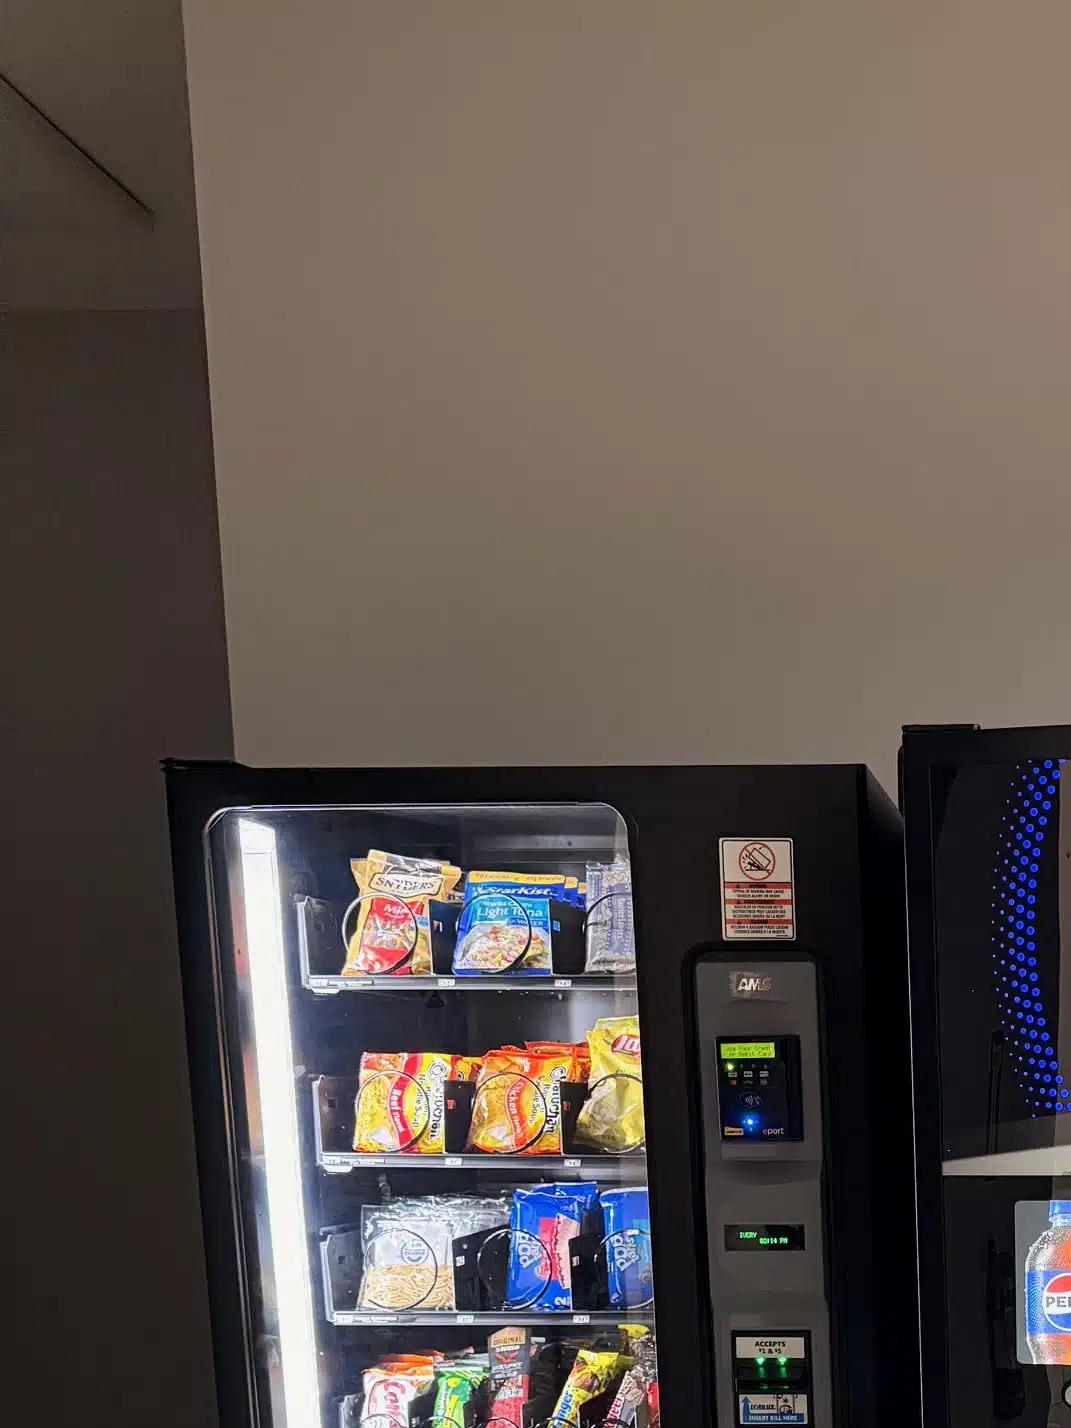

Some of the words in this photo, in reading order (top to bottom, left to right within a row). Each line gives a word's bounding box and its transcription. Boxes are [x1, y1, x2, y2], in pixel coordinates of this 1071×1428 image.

[477, 906, 509, 918] Light
[738, 978, 771, 991] AMS
[762, 1127, 785, 1136] eport
[493, 1335, 523, 1346] ORIGINAL
[754, 1340, 786, 1348] ACCEPTS
